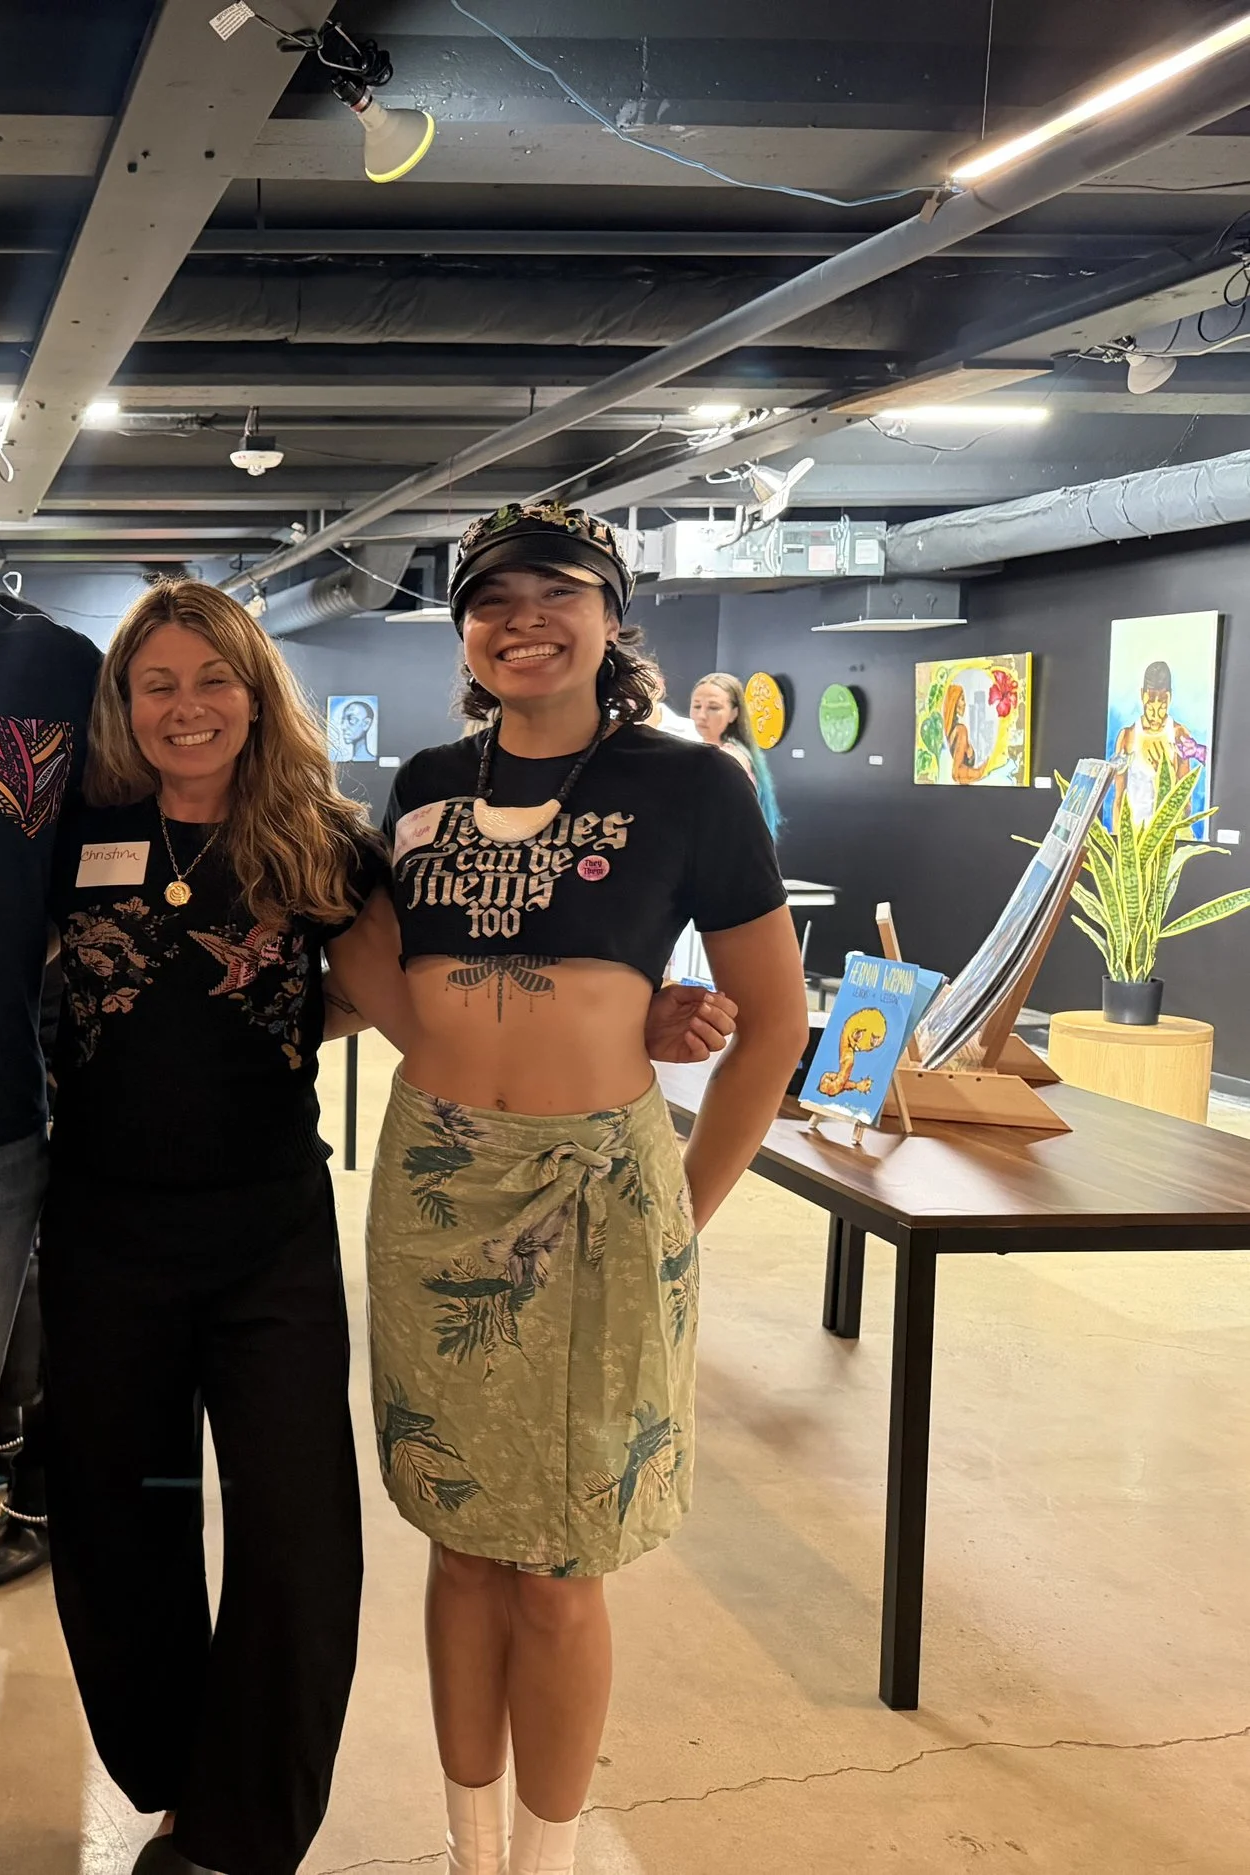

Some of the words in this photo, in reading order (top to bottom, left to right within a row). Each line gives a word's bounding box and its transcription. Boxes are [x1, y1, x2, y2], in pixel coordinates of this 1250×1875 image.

[399, 842, 563, 911] Thems
[456, 847, 521, 872] can
[529, 845, 575, 874] be
[465, 901, 521, 939] too
